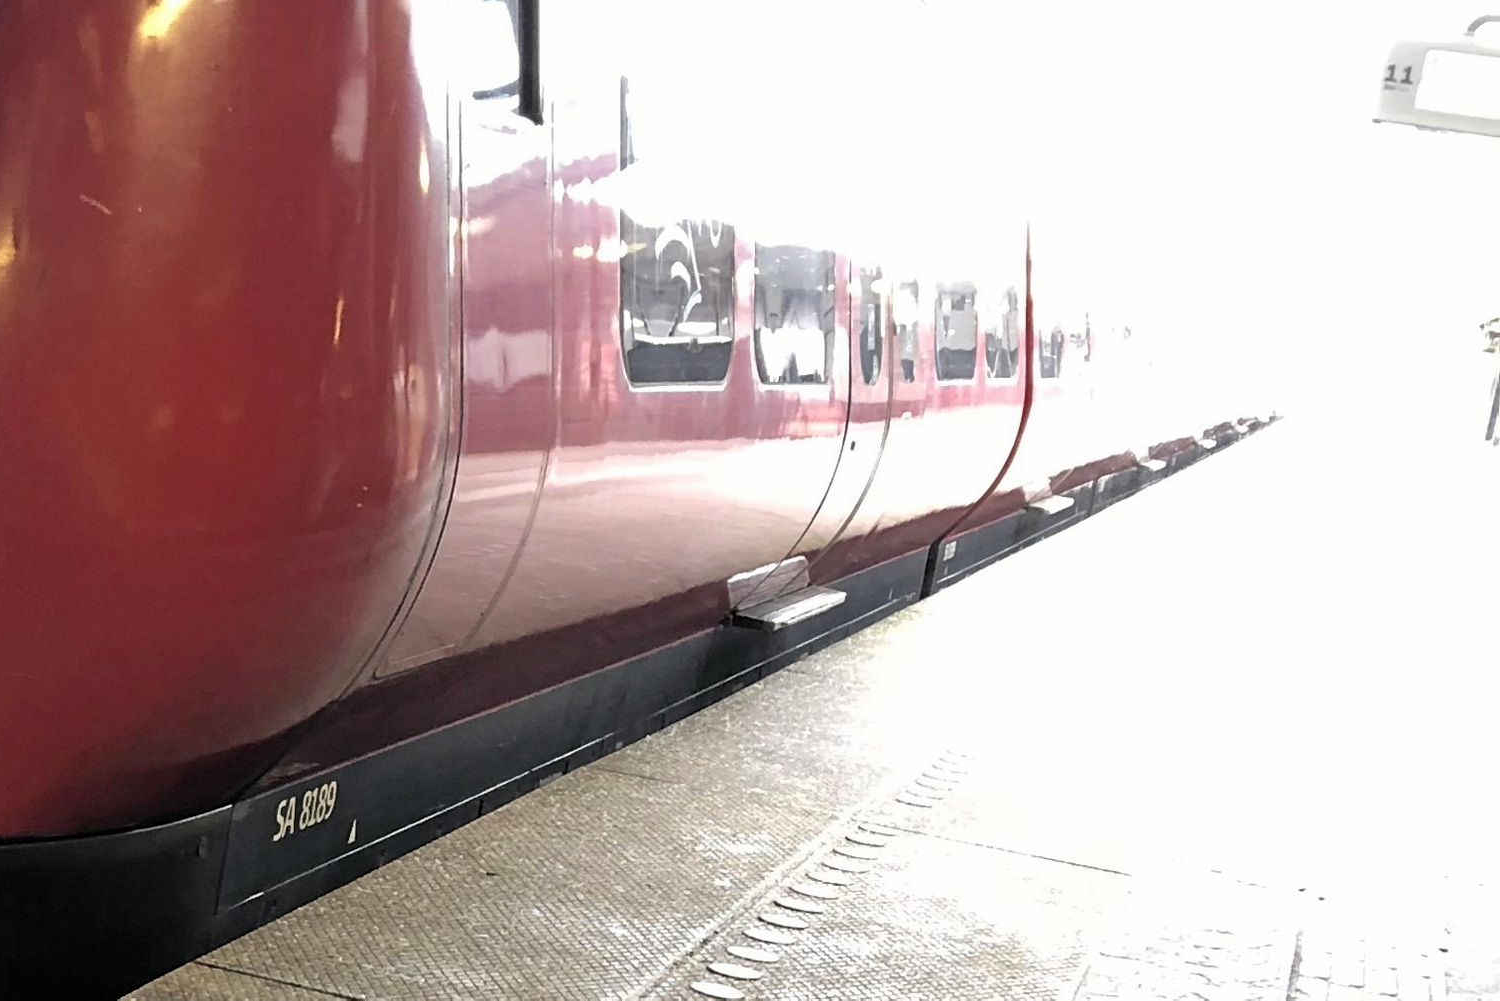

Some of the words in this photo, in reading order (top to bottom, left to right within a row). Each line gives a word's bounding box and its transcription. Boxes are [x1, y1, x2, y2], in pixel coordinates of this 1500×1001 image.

[1383, 63, 1414, 85] 11
[272, 796, 296, 842] SA
[299, 780, 337, 830] 8189
